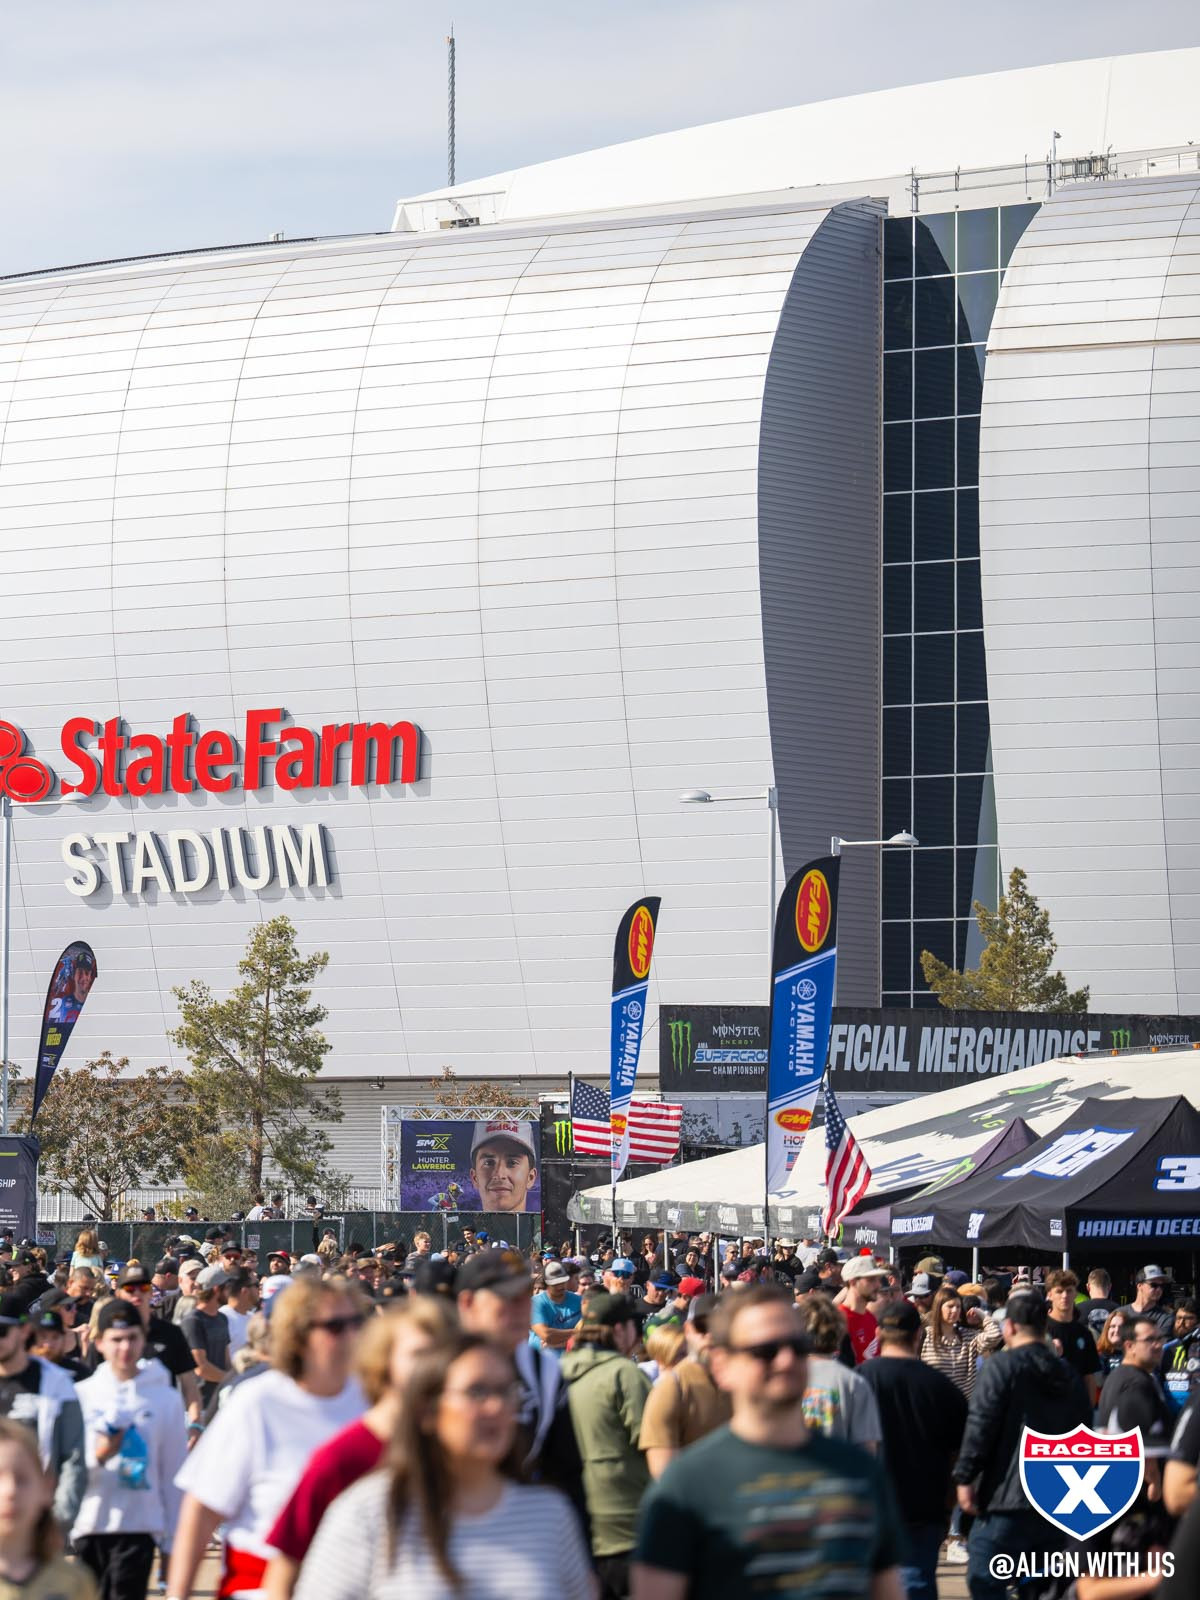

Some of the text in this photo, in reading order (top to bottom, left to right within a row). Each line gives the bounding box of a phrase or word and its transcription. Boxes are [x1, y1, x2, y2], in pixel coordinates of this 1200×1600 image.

[62, 823, 330, 897] STADIUM
[48, 997, 63, 1018] 2
[712, 1024, 760, 1037] MONSTER
[795, 1002, 816, 1077] YAMAHA
[1149, 1033, 1190, 1044] MONSTER
[620, 1021, 640, 1087] YAMAHA
[694, 1049, 768, 1062] SUPERCRO
[712, 1066, 765, 1075] CHAMPIONSHIP
[416, 1136, 449, 1150] SMX
[1078, 1220, 1152, 1237] HAIDEN
